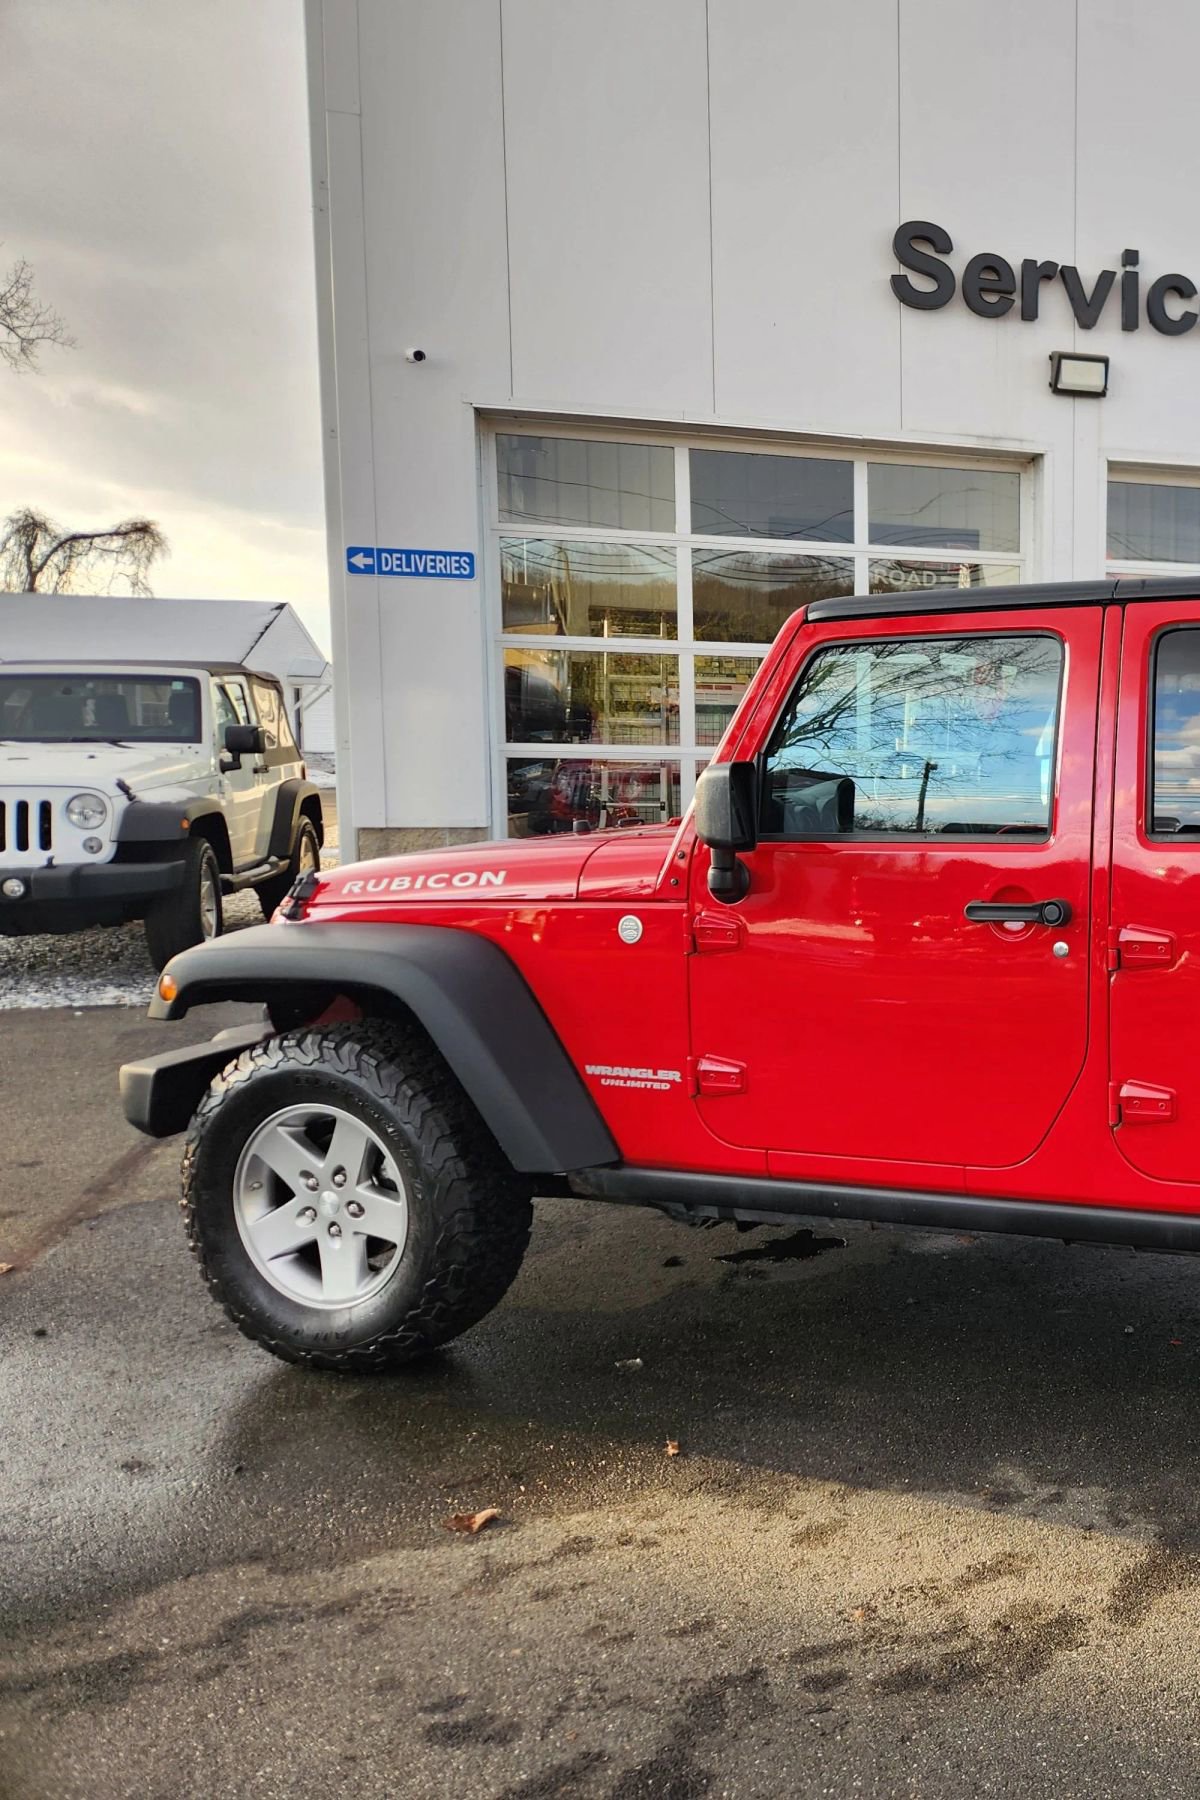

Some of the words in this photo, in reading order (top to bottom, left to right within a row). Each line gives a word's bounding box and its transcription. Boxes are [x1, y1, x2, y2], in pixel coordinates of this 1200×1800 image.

[380, 552, 471, 576] DELIVERIES
[873, 568, 937, 587] ROAD
[341, 870, 507, 895] RUBICON
[584, 1064, 682, 1082] WRANGLER
[600, 1078, 671, 1091] UNLIMITED
